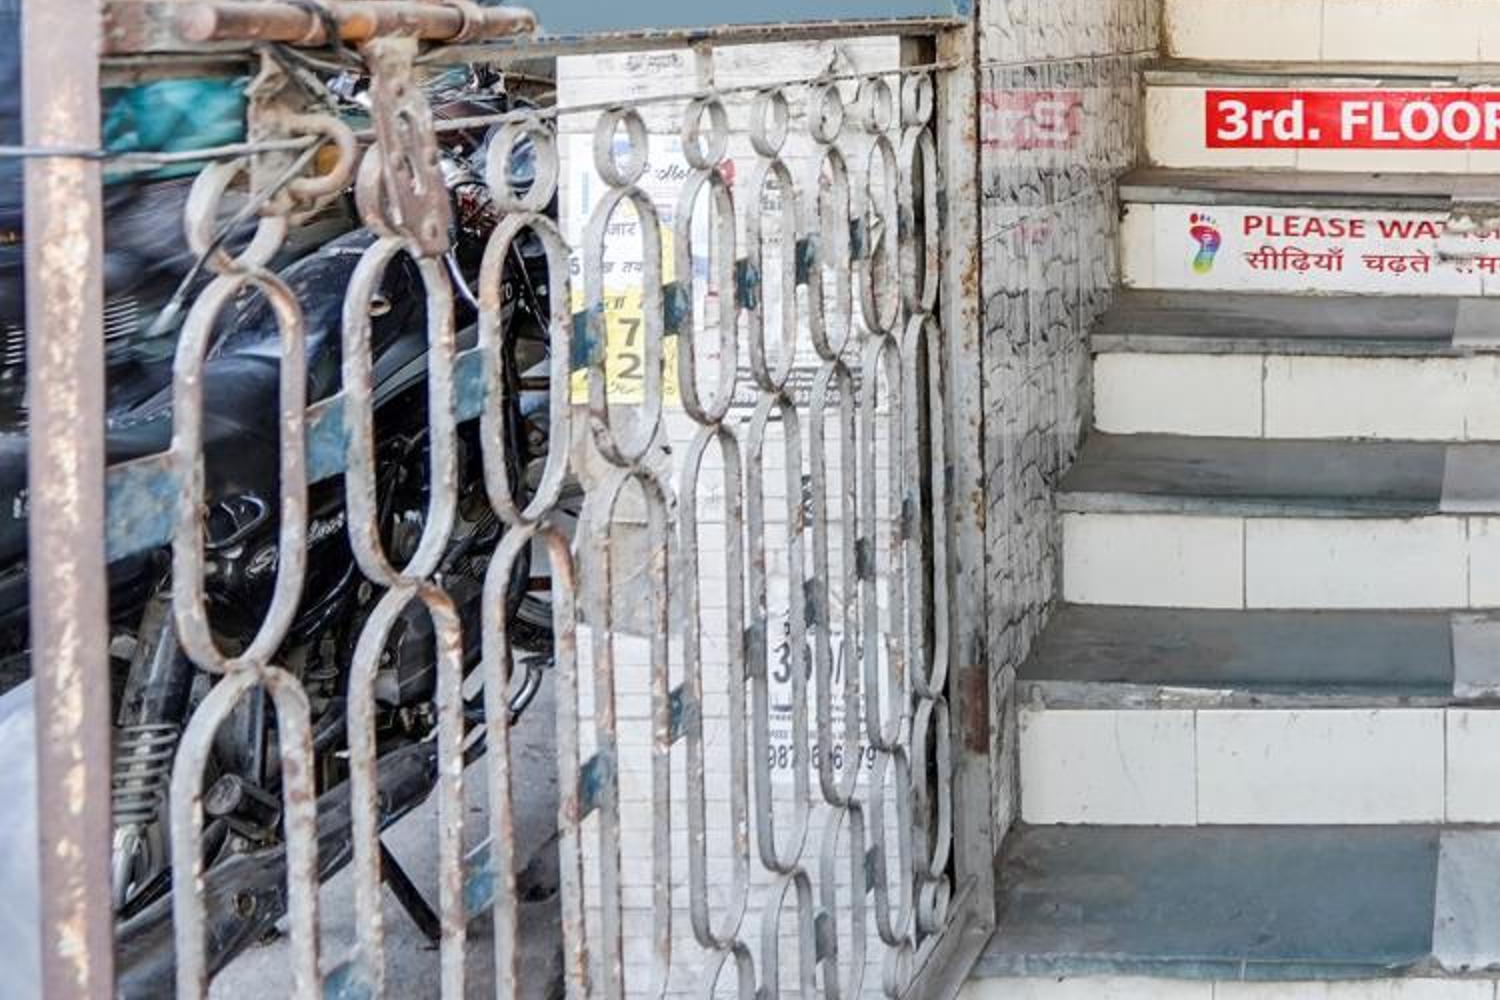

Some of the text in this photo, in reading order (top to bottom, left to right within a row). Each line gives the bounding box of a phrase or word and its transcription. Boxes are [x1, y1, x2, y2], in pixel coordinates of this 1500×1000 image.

[1216, 100, 1320, 141] 3rd.
[1243, 215, 1366, 239] PLEASE
[1245, 244, 1344, 275] सीढ़ियाँ
[1361, 248, 1431, 277] चढ़ते
